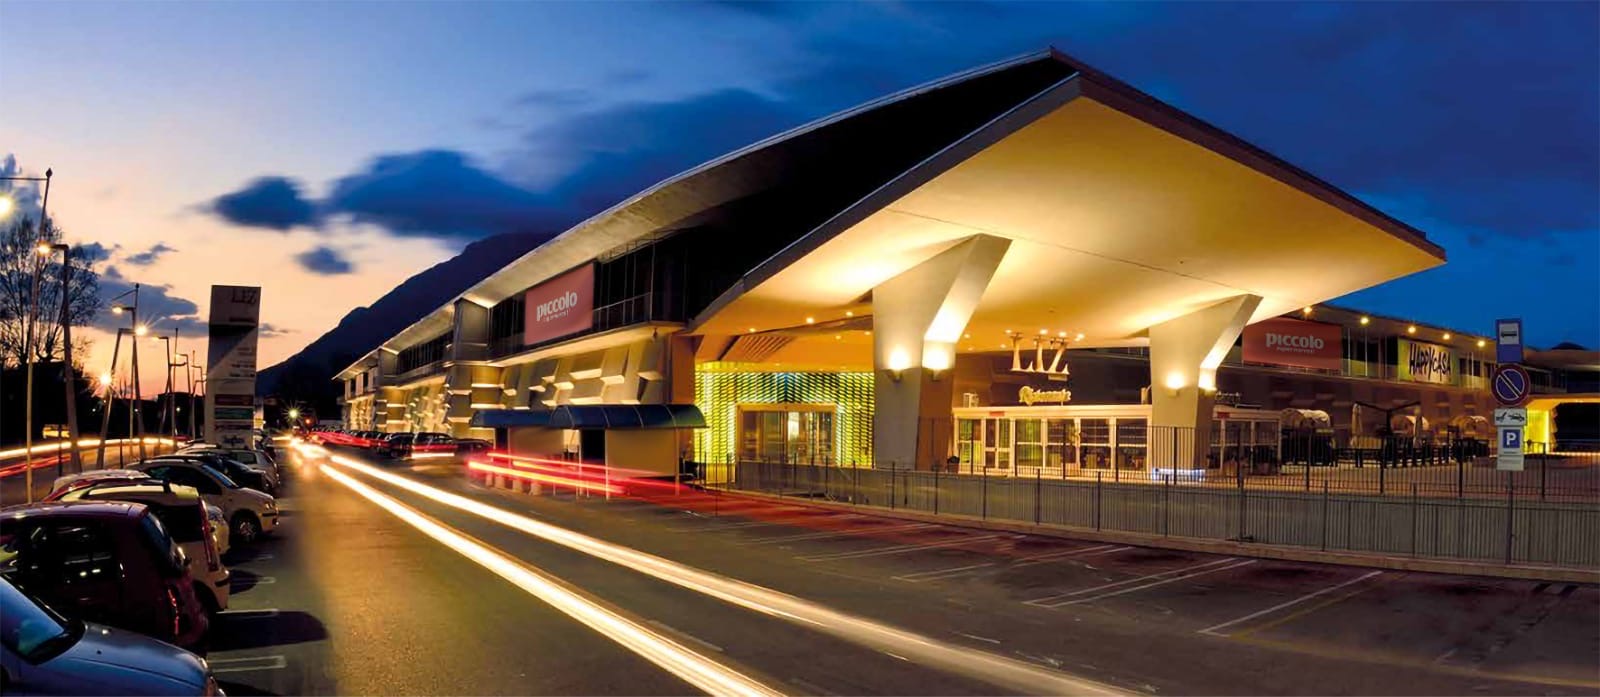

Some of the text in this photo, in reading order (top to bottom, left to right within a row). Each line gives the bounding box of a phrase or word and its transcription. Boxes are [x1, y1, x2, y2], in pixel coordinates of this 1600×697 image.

[536, 291, 578, 321] piccolo
[1265, 333, 1324, 349] piccolo
[1010, 336, 1070, 375] LIZ
[1506, 432, 1517, 446] P
